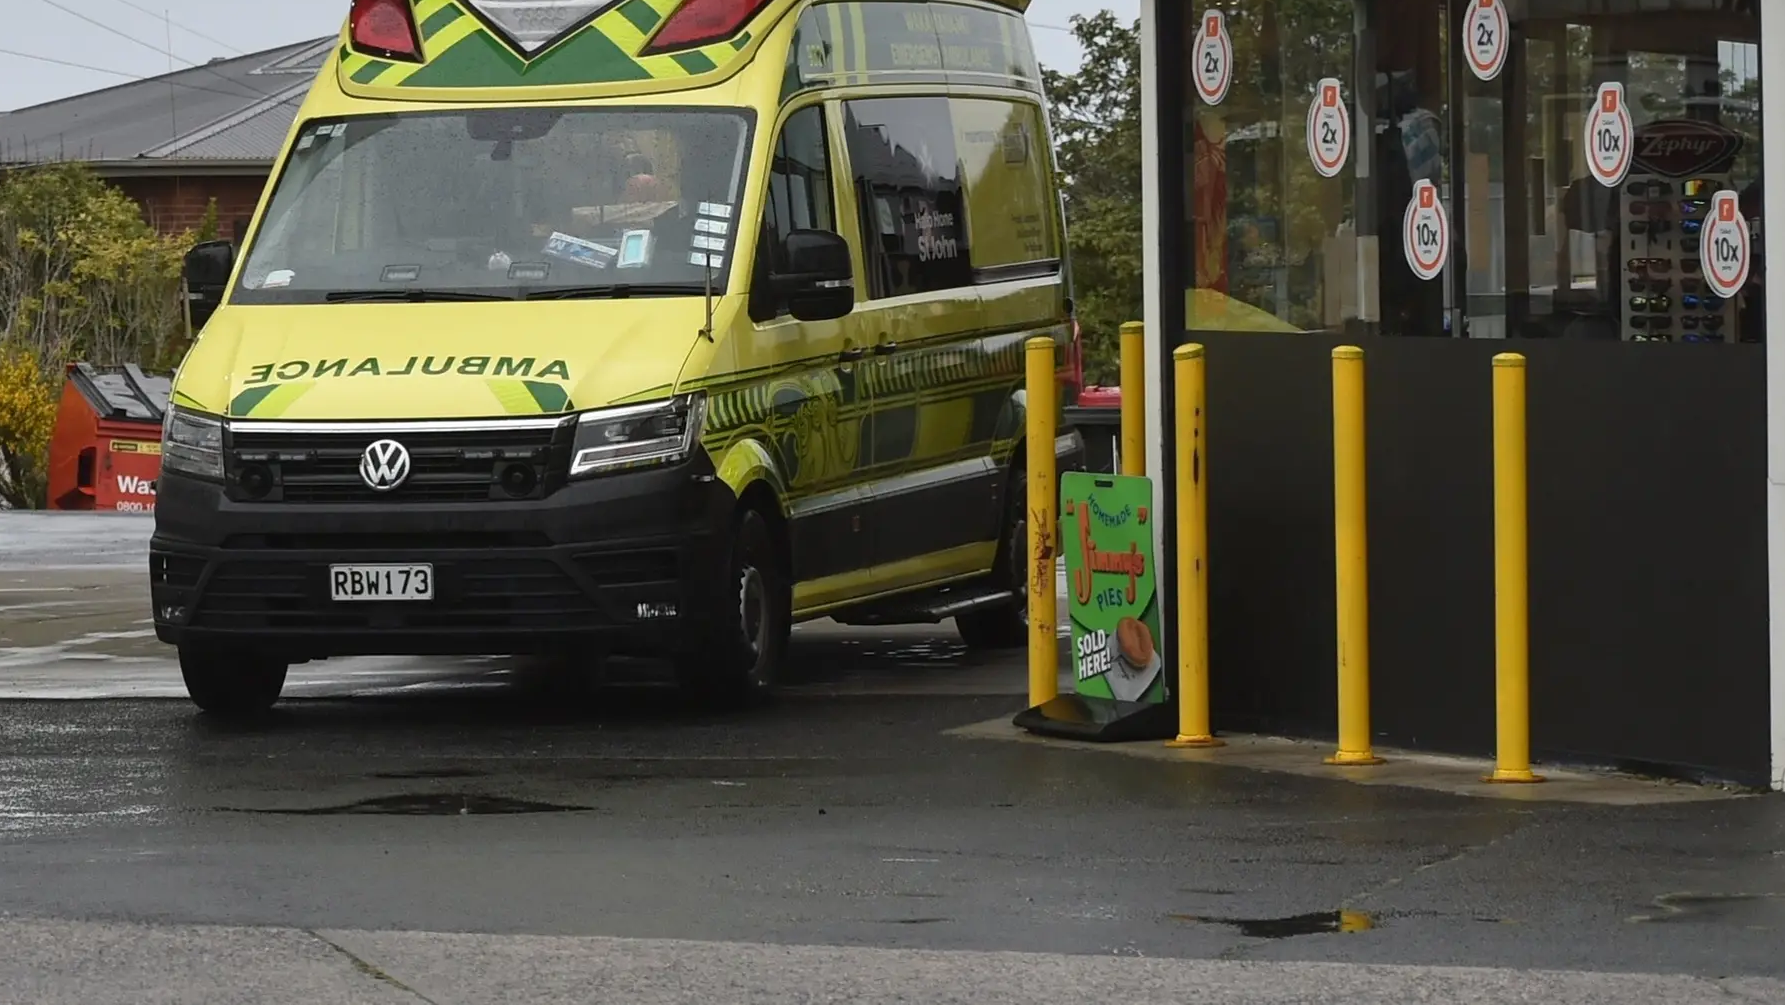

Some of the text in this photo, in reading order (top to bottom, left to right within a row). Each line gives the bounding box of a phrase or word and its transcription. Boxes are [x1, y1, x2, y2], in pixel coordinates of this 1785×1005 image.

[1477, 23, 1494, 46] 2x
[1204, 52, 1219, 74] 2x
[1321, 121, 1337, 145] 2x
[1597, 128, 1620, 153] 10x
[1640, 133, 1717, 157] Zephyr
[1416, 223, 1438, 247] 10x
[1714, 237, 1739, 263] 10x
[1088, 493, 1131, 528] HOMEMADE
[334, 569, 429, 596] RBW173
[1096, 587, 1123, 612] PIES
[1077, 629, 1106, 657] SOLD
[1078, 649, 1112, 681] HERE!
